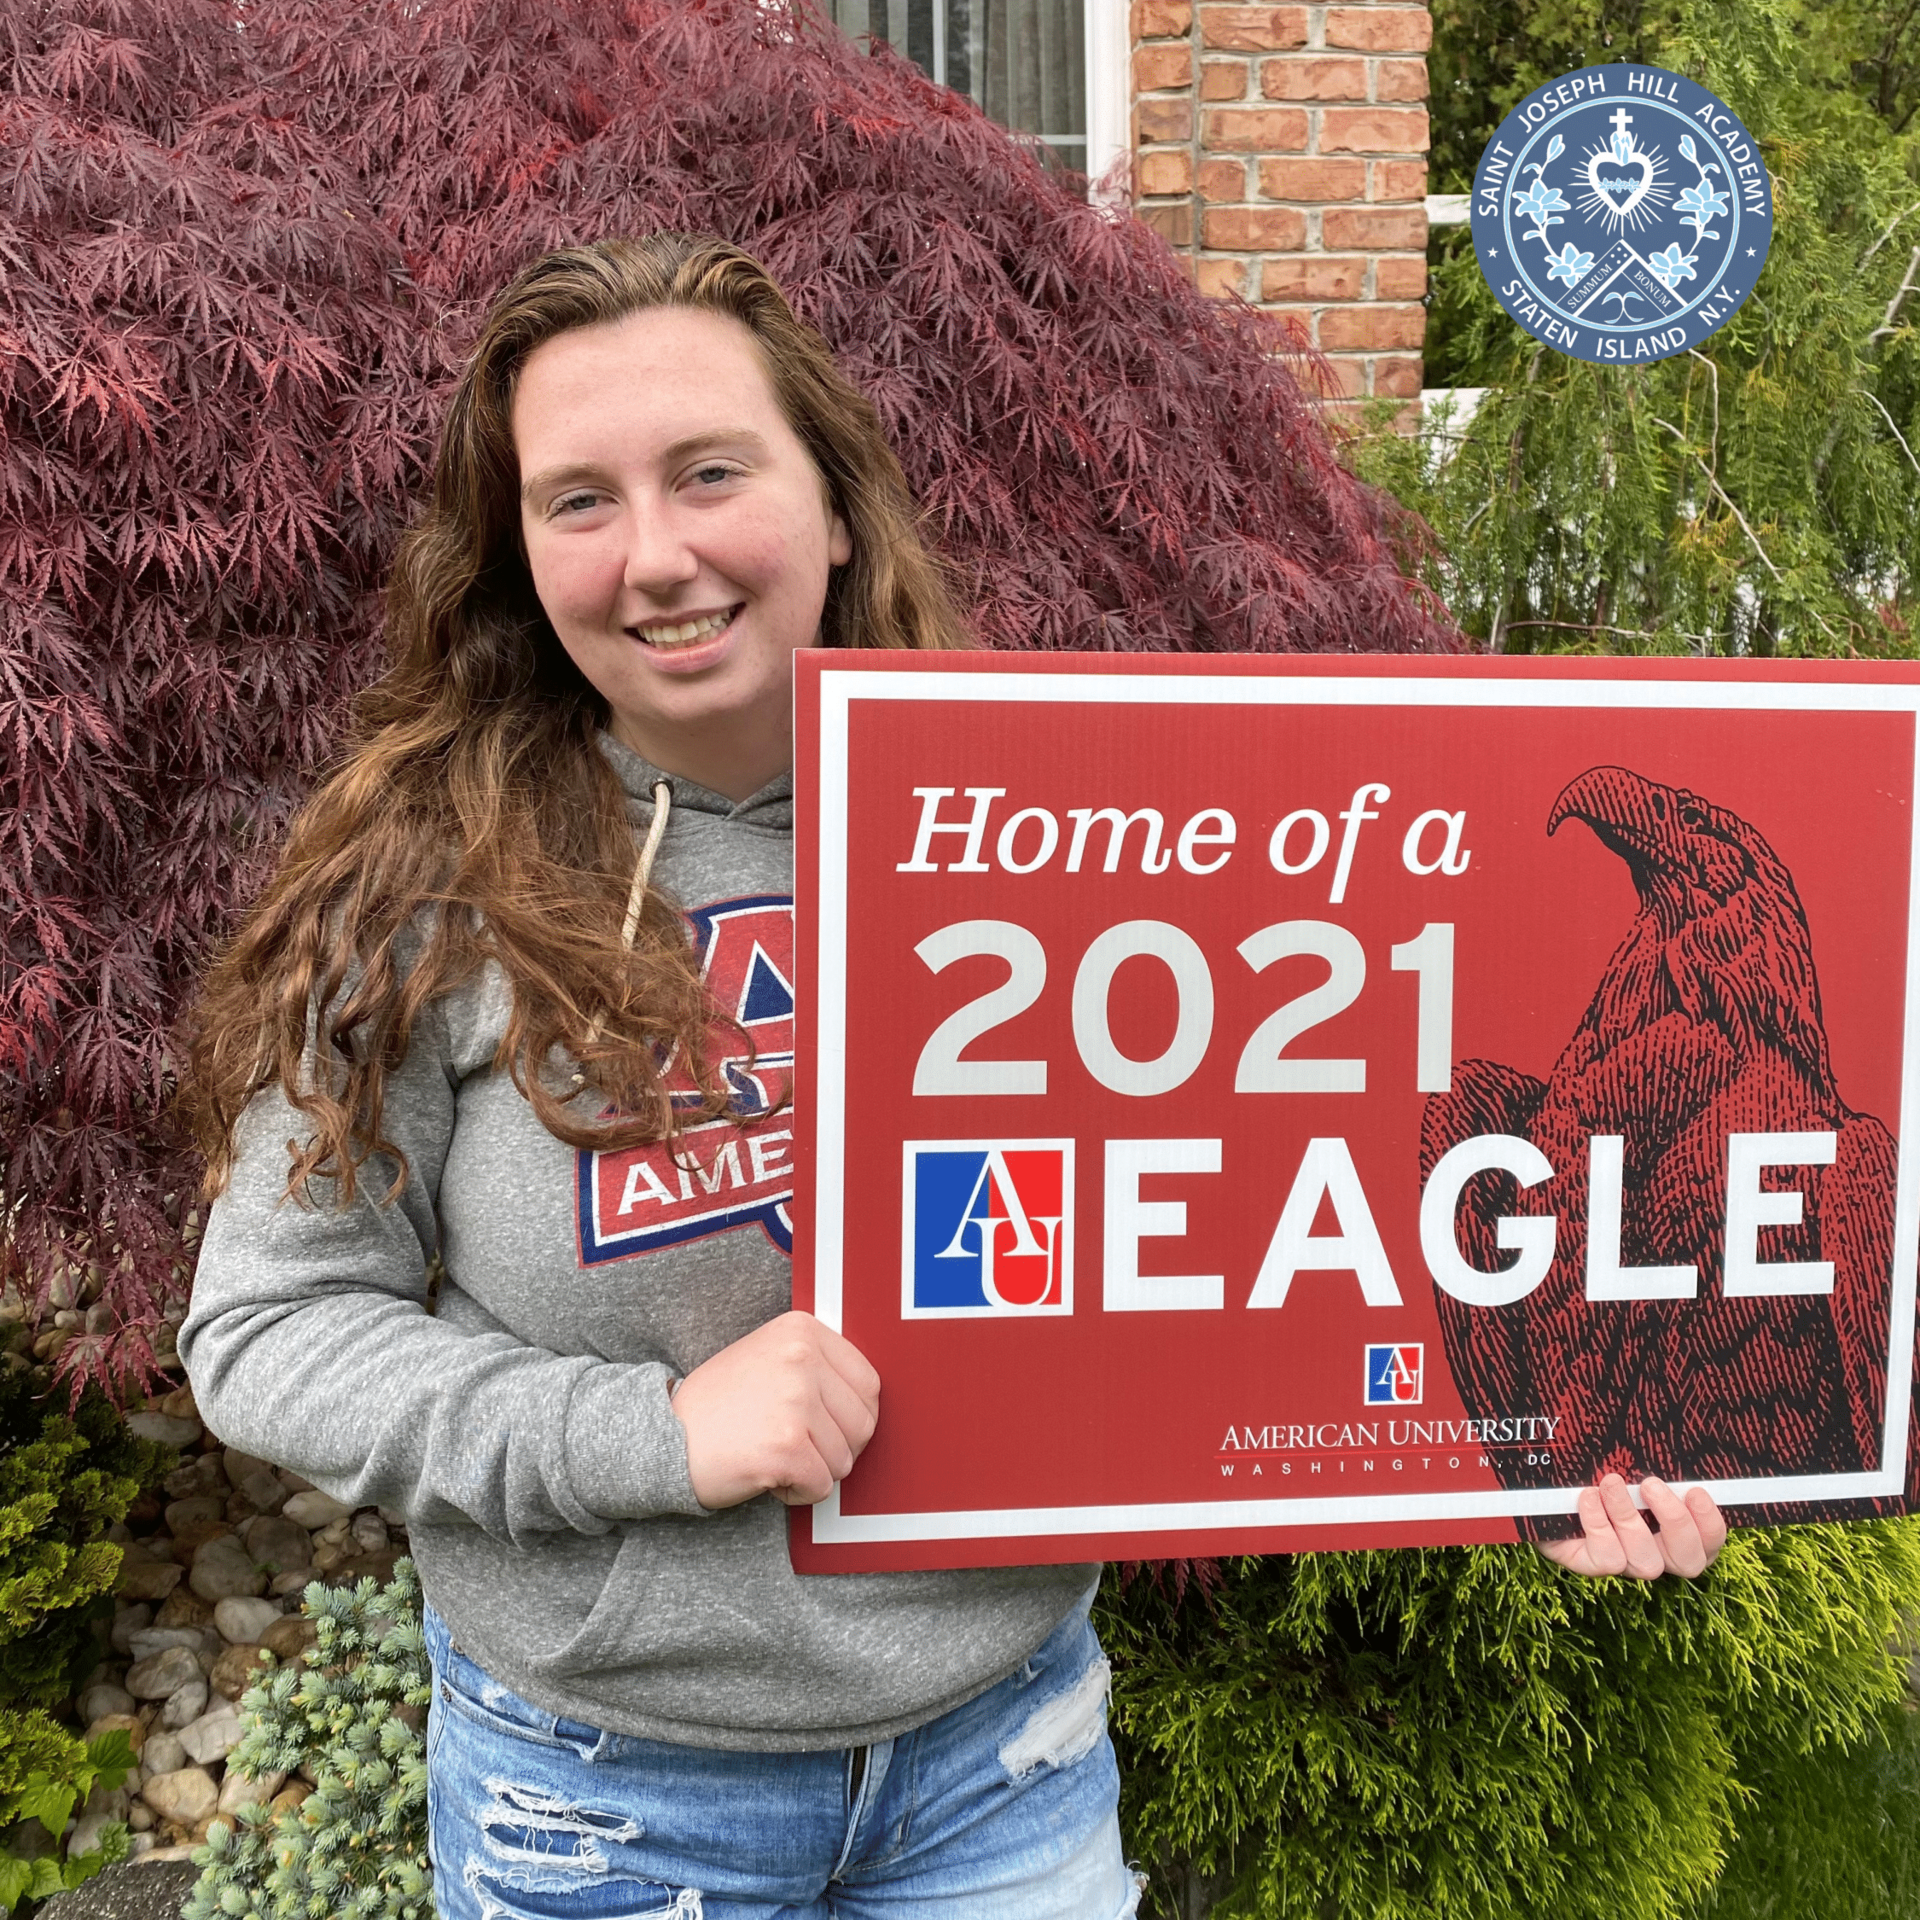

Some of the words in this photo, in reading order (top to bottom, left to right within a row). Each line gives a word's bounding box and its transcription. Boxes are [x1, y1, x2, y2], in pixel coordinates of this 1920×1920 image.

[896, 786, 1238, 876] Home
[1268, 782, 1391, 904] of
[1402, 808, 1472, 876] a
[911, 918, 1455, 1096] 2021
[1102, 1131, 1838, 1312] EAGLE
[1219, 1423, 1379, 1451] AMERICAN
[1389, 1417, 1561, 1446] UNIVERSITY
[1528, 1453, 1551, 1466] DC
